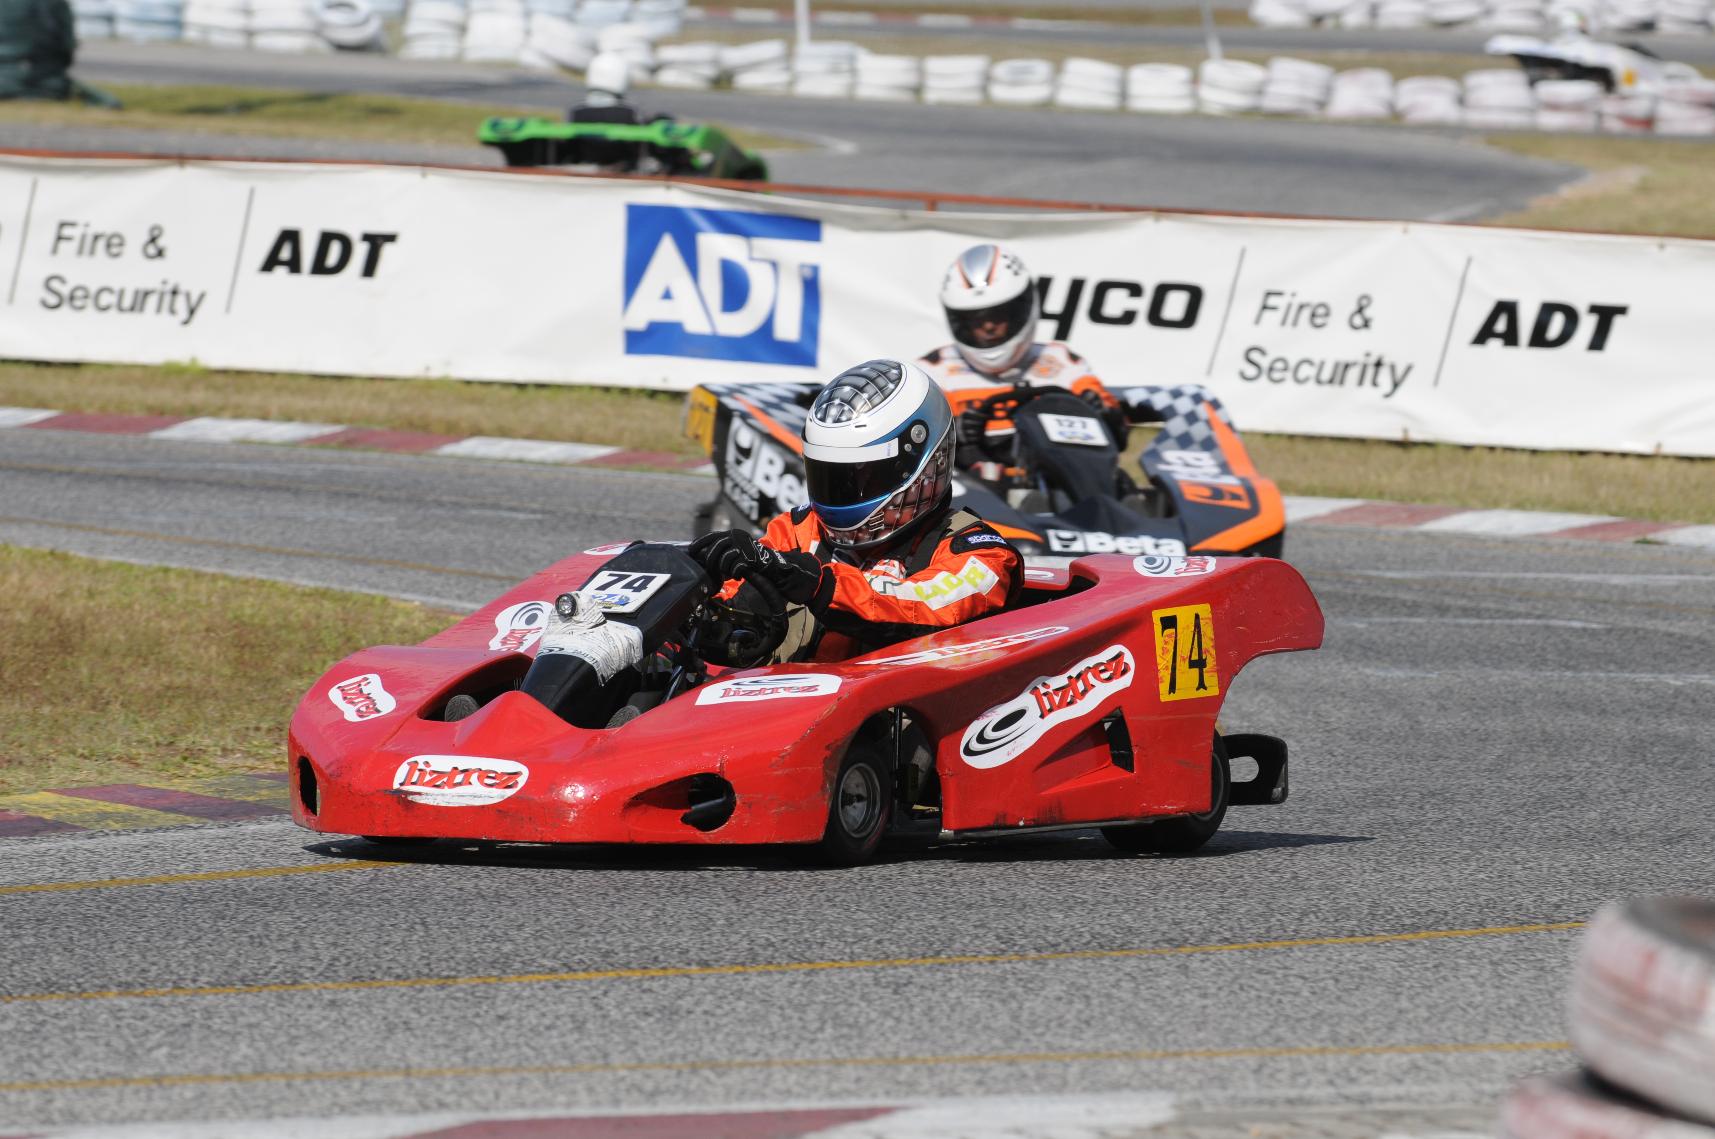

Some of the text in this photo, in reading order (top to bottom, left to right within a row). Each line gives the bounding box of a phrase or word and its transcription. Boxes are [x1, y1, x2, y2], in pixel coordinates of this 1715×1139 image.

[50, 221, 167, 260] Fire &
[260, 228, 398, 278] ADT
[40, 273, 205, 325] Security
[623, 231, 822, 342] ADT
[1037, 276, 1203, 341] yco
[1253, 290, 1374, 331] Fire &
[1470, 299, 1629, 352] ADT
[1239, 346, 1414, 398] Security
[1084, 531, 1186, 557] Beta
[595, 573, 657, 592] 74
[1159, 613, 1208, 695] 74
[720, 684, 820, 698] liztrez
[1029, 651, 1131, 720] liztrez
[399, 760, 523, 790] liztrez
